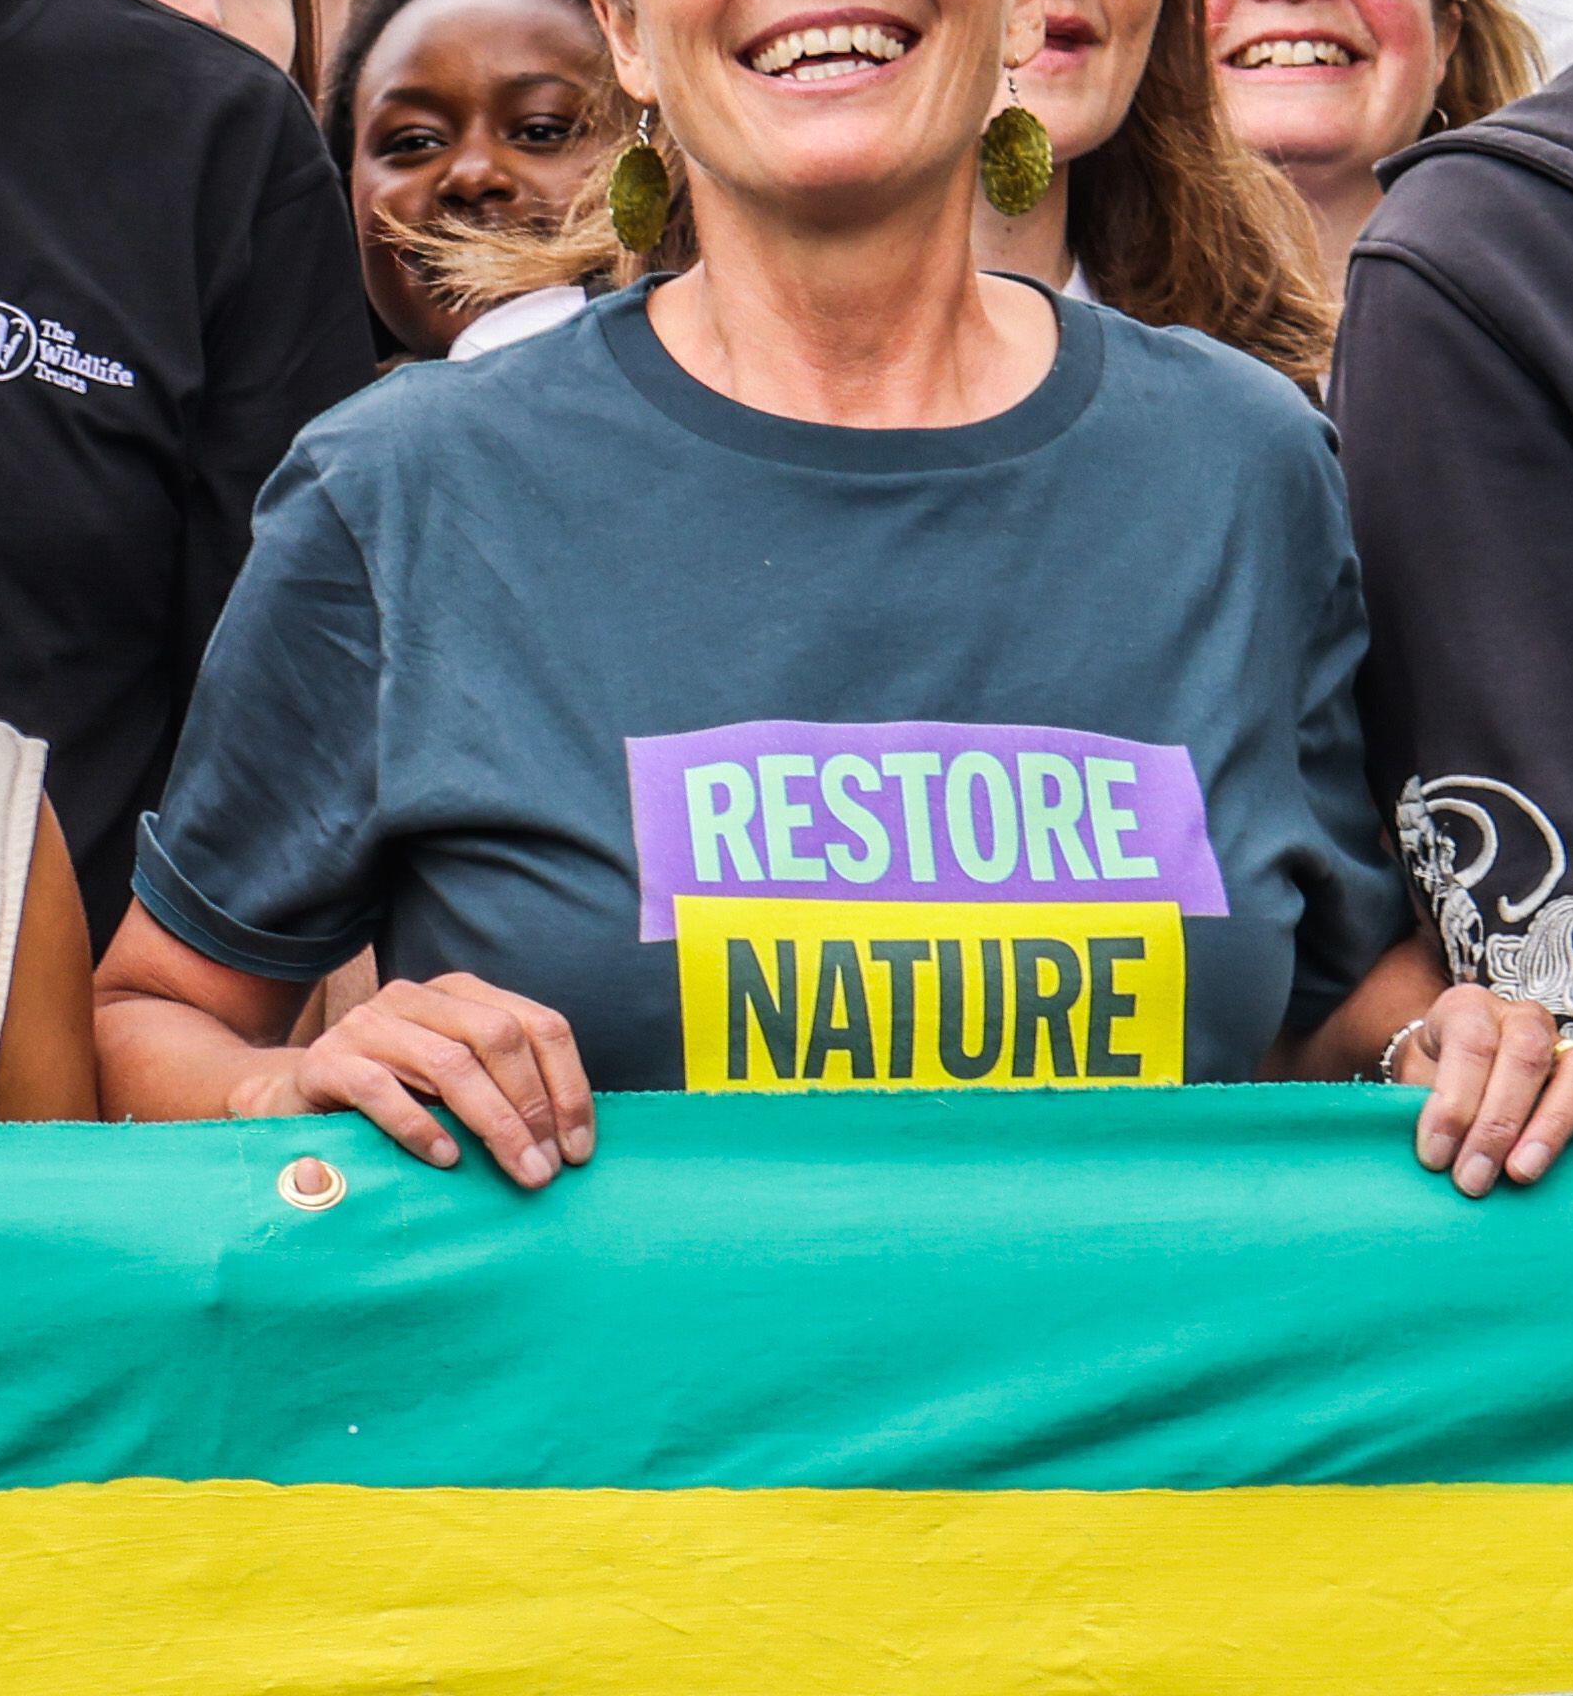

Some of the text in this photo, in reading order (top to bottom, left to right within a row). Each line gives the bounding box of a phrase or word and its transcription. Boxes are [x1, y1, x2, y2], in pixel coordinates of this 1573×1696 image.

[39, 317, 76, 346] The
[33, 360, 88, 395] Trusts
[38, 338, 135, 388] Wildlife
[683, 750, 1160, 884] RESTORE
[726, 936, 1147, 1082] NATURE
